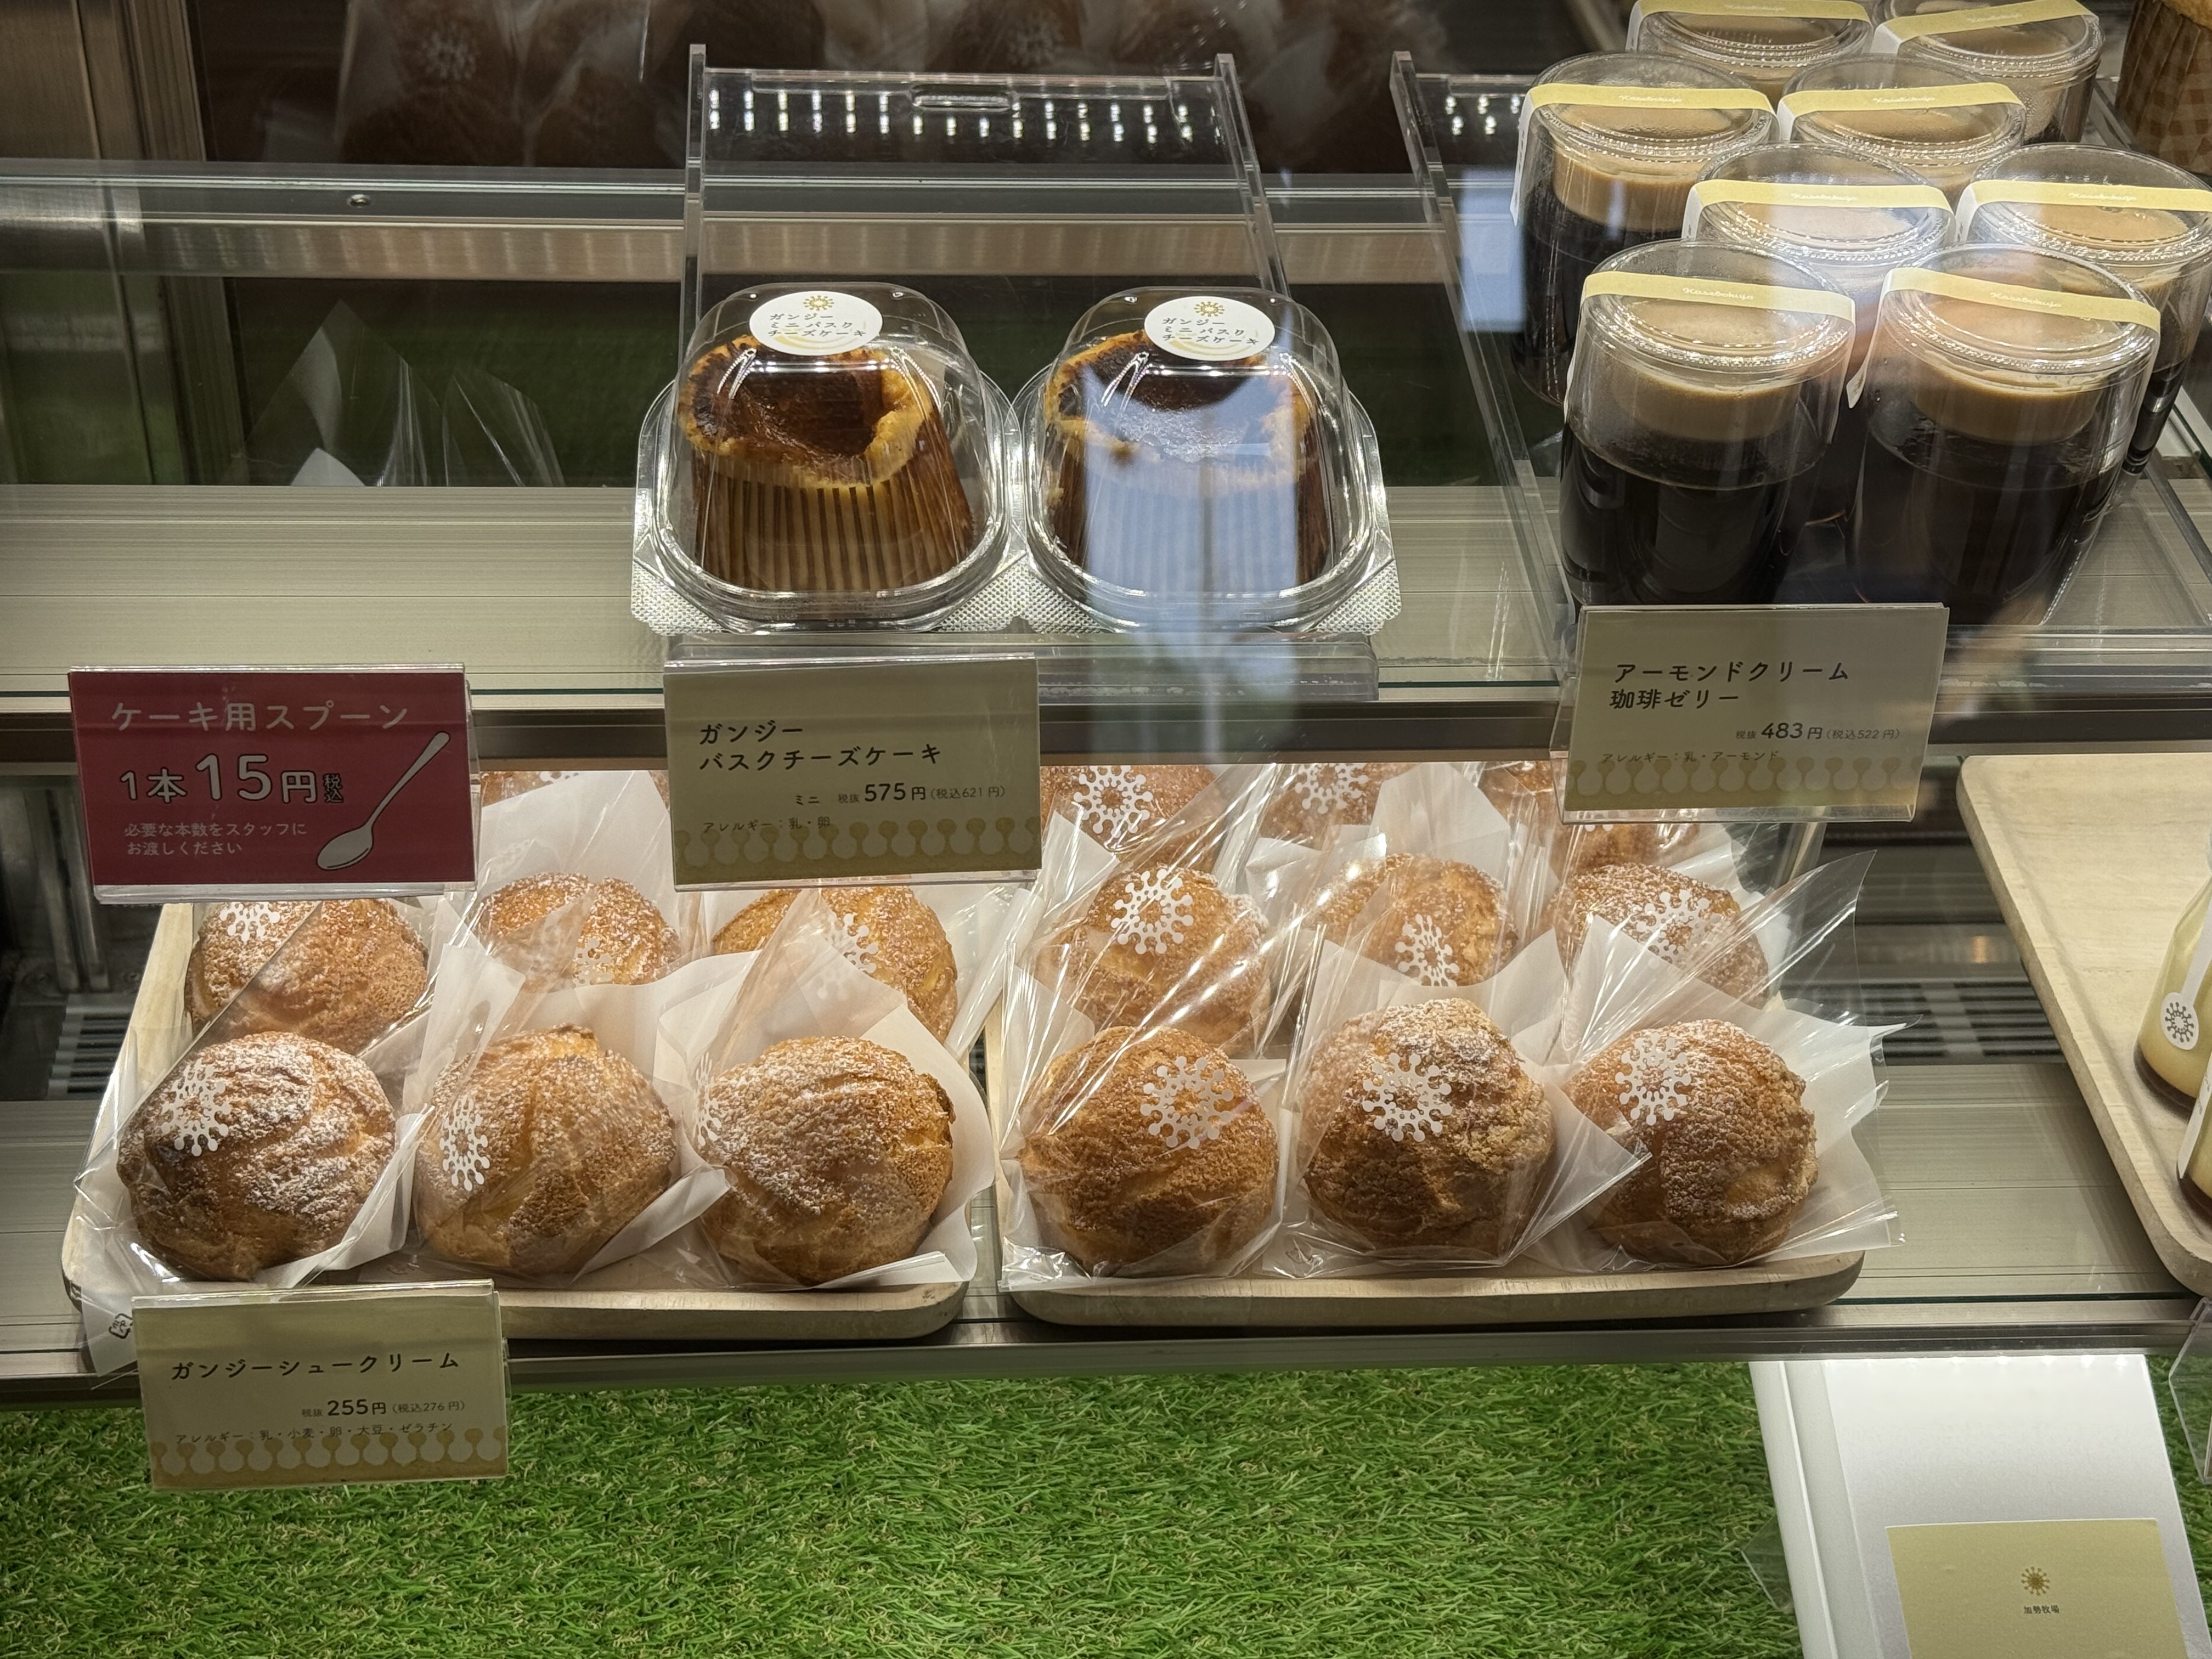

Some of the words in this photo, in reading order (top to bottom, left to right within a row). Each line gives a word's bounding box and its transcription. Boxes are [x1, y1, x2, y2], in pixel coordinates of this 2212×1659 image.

[1163, 318, 1225, 326] ガンジー
[1163, 334, 1259, 345] チーズケーキ
[1615, 661, 1848, 683] アーモンドクリーム
[1609, 689, 1739, 710] 珈琲ゼリー
[111, 700, 408, 731] ケーキ用スプーン
[699, 720, 803, 745] ガンジー
[699, 743, 941, 771] バスクチーズケーキ
[125, 822, 307, 837] 必要な本数をスタッフに
[127, 842, 242, 856] お渡しください
[172, 1352, 459, 1380] ガンジーシュークリーム
